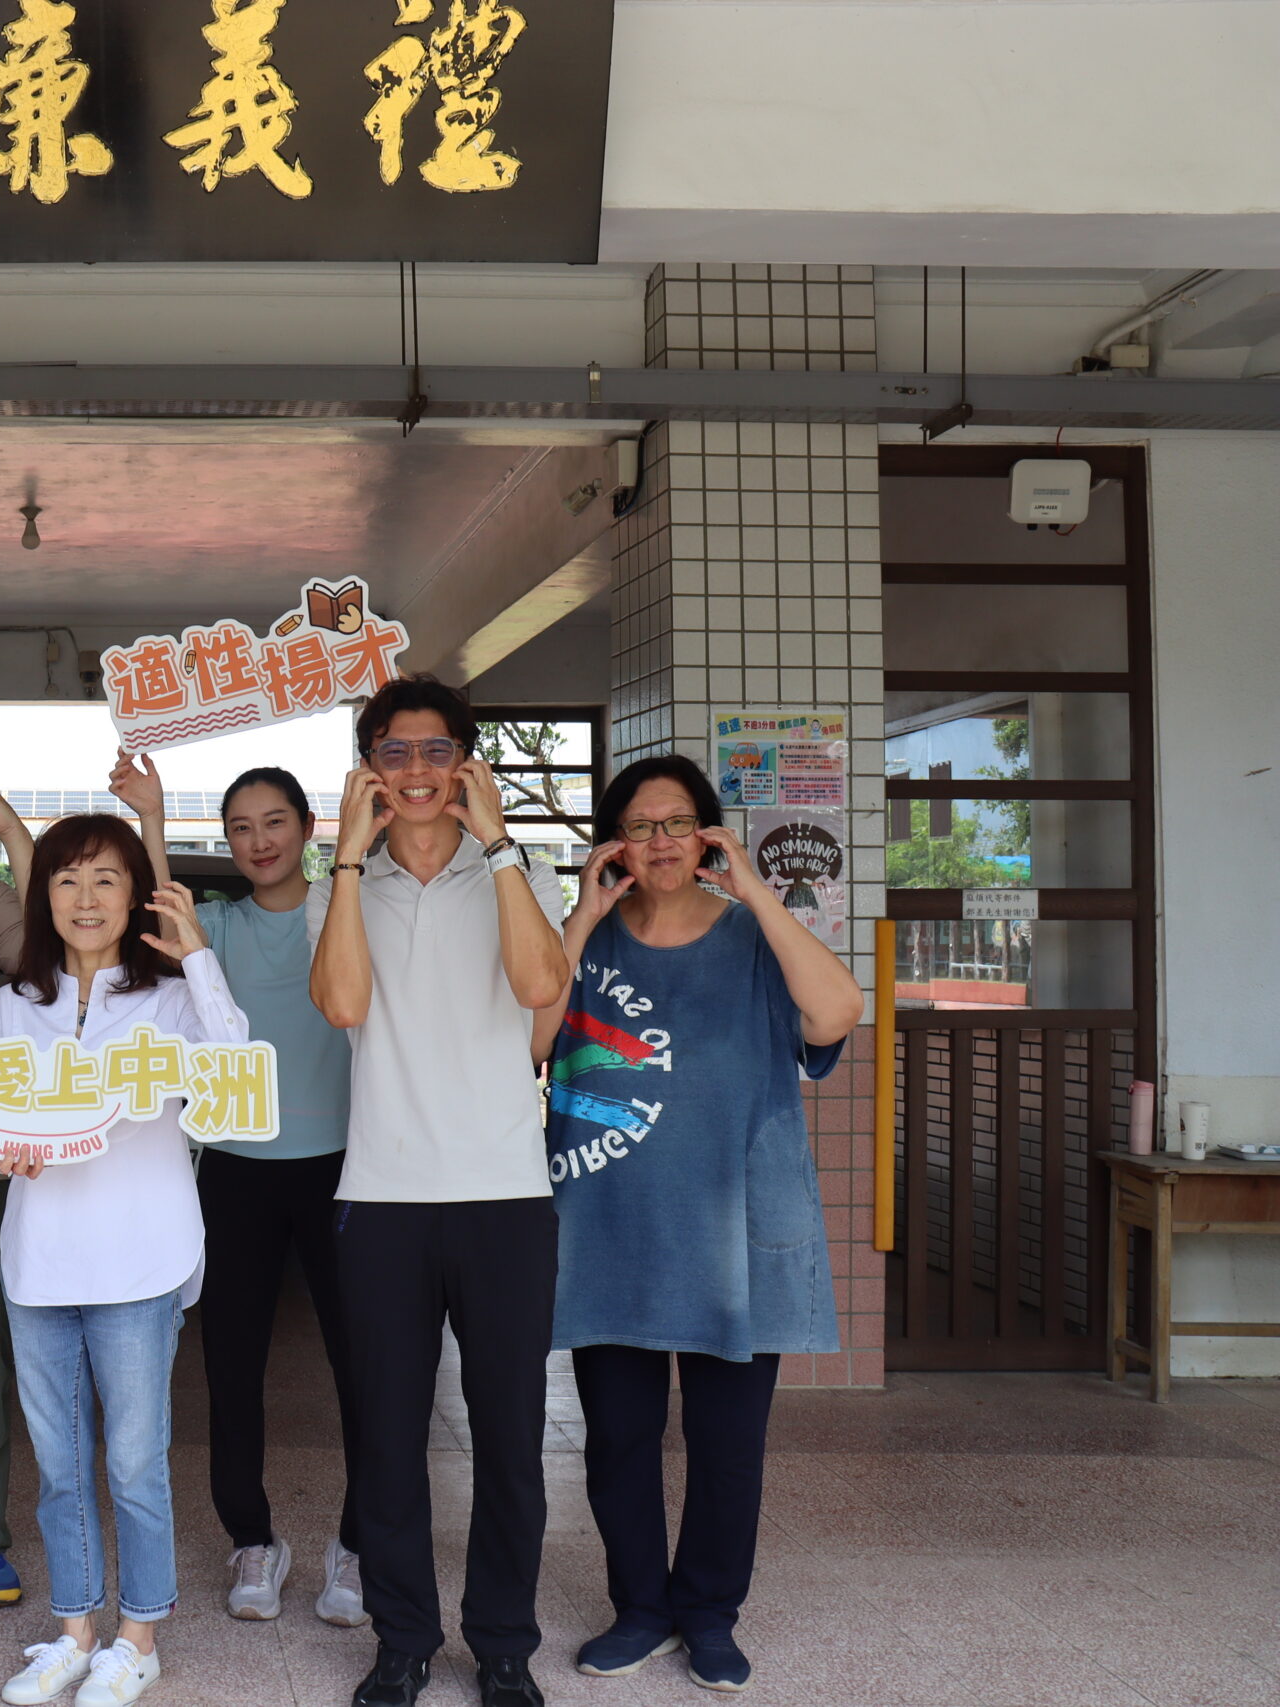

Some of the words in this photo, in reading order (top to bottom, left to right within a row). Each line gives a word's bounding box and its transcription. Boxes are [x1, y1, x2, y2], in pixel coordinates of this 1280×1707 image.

[109, 622, 403, 717] 適性揚才
[761, 844, 780, 863] NO
[781, 838, 838, 863] SMOKING
[768, 861, 781, 875] IN
[782, 857, 805, 871] THIS
[806, 858, 831, 875] AREA
[59, 1134, 103, 1159] JHOU
